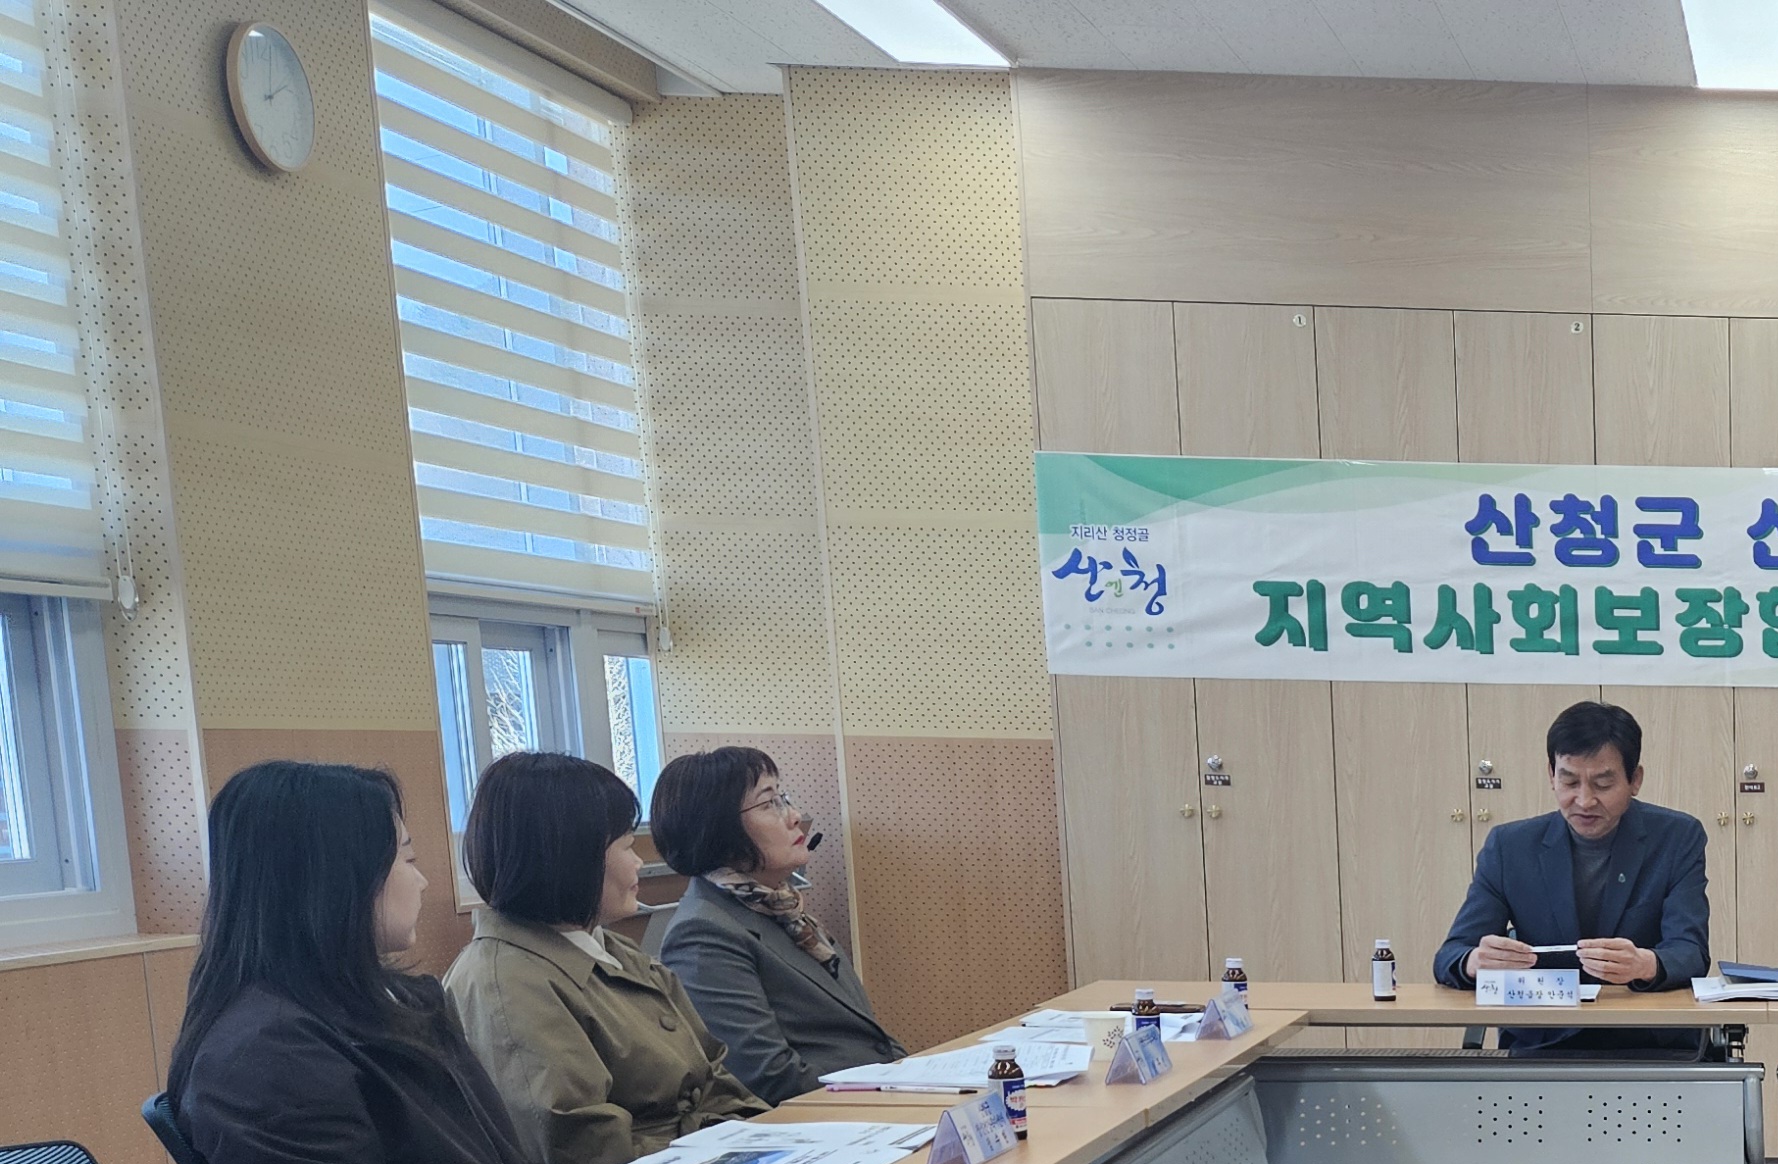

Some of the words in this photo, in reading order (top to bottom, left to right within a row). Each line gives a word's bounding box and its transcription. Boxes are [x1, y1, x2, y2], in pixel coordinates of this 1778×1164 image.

[1071, 525, 1107, 541] 지리산
[1112, 526, 1149, 542] 청정골
[1464, 493, 1704, 569] 산청군
